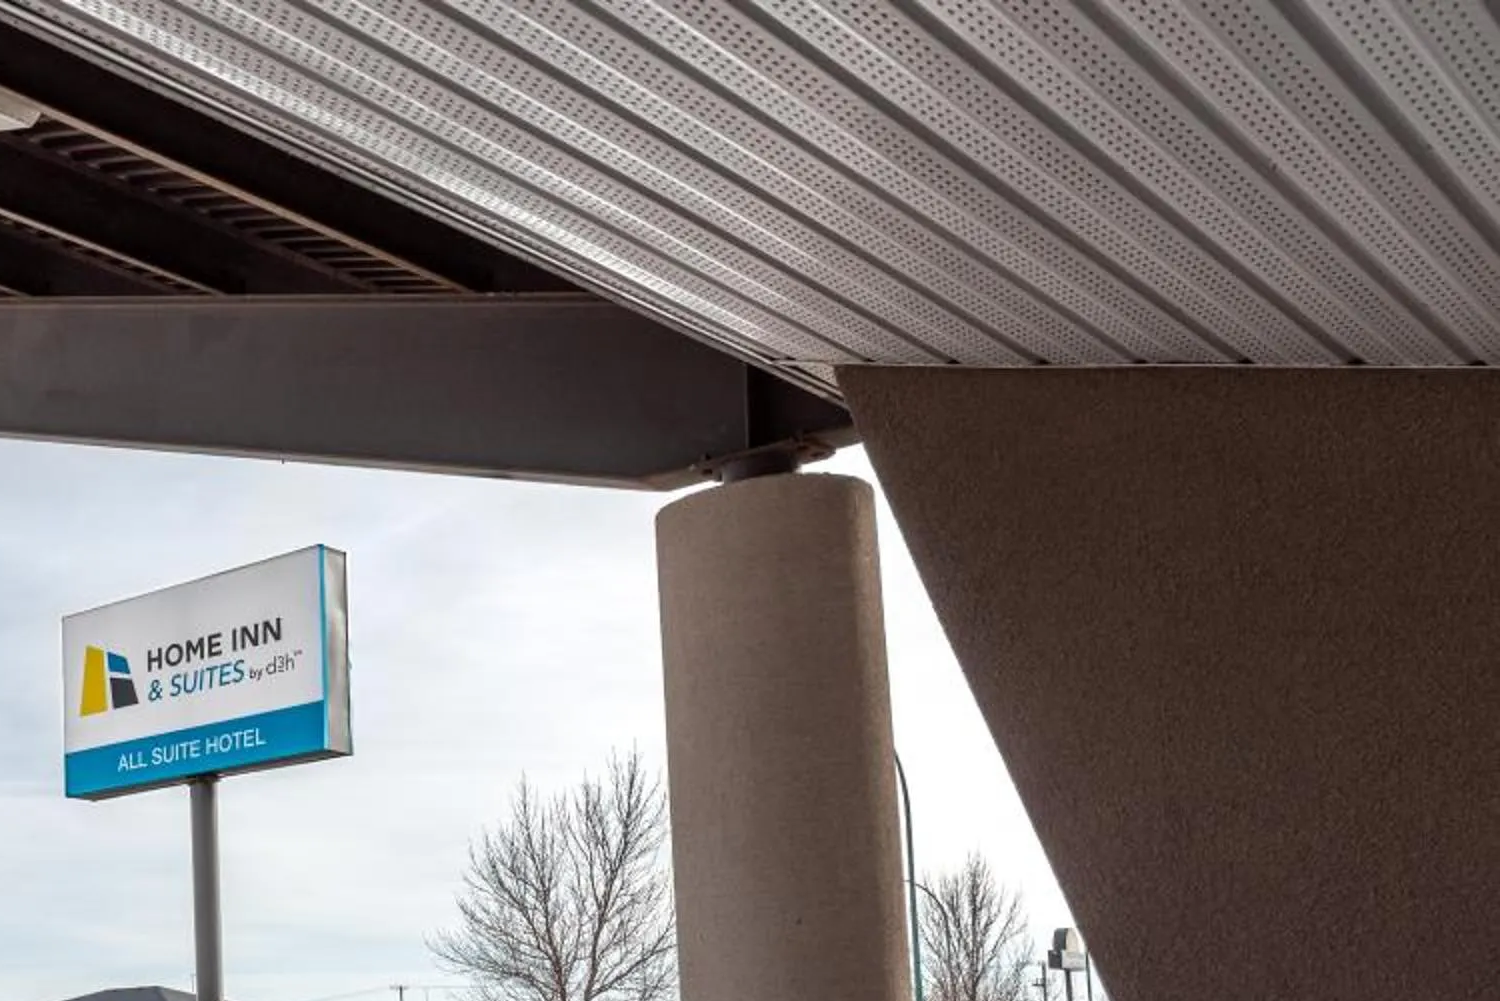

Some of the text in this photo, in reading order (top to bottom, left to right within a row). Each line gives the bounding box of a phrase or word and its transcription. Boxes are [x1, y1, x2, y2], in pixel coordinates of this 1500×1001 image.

[147, 617, 282, 673] HOME INN
[147, 679, 163, 702] &
[169, 659, 245, 697] SUITES
[249, 667, 263, 681] by
[117, 728, 267, 772] ALL SUITE HOTEL
